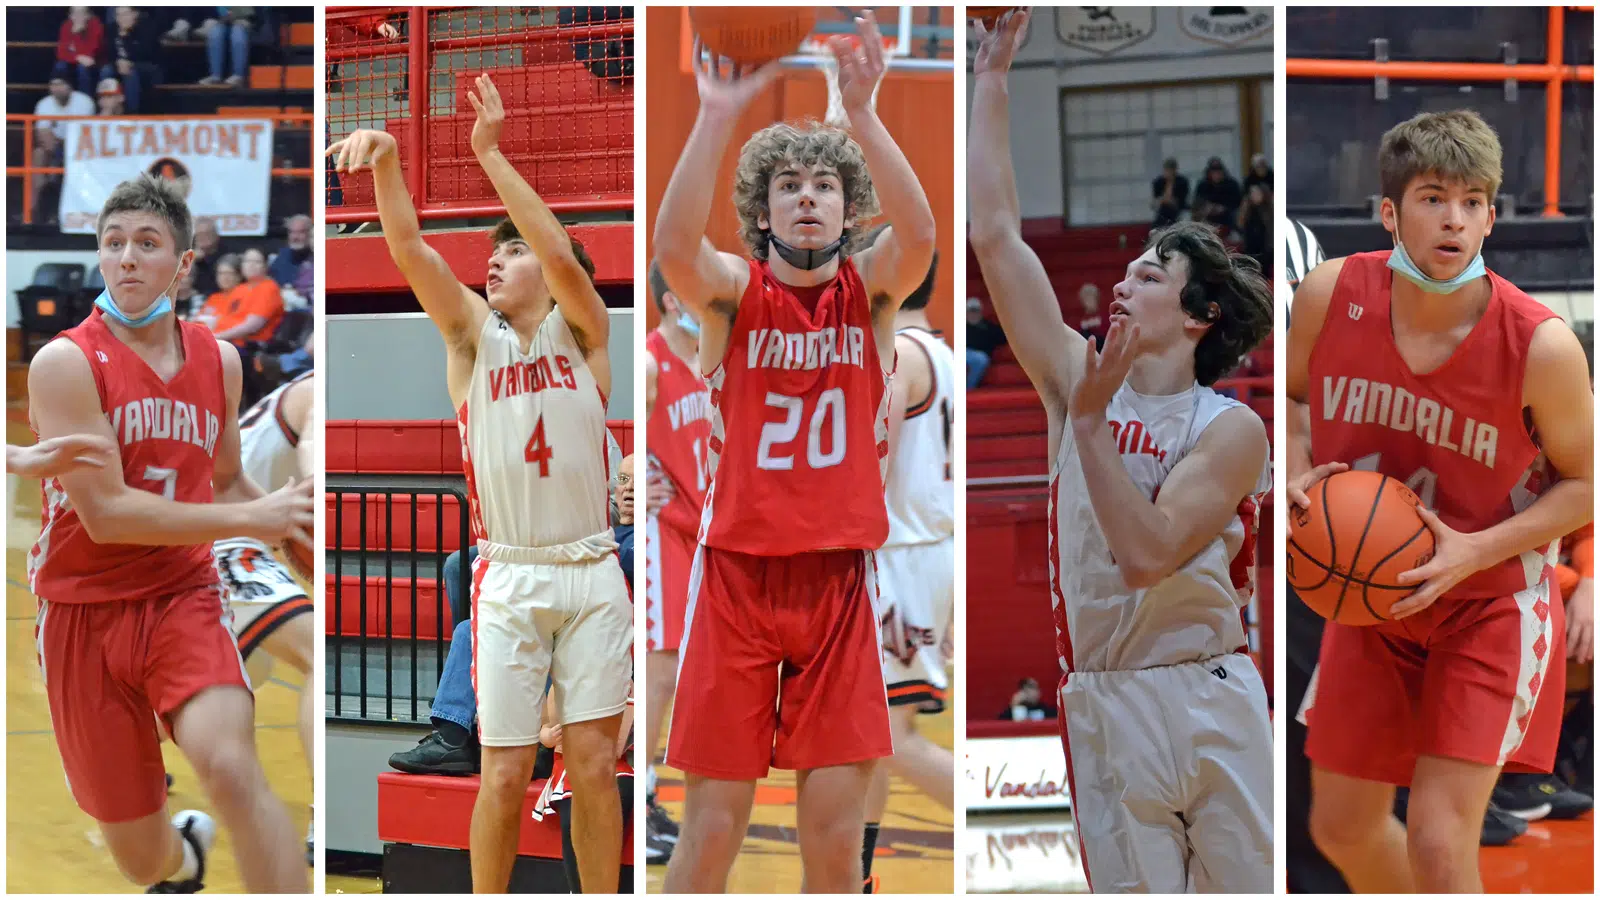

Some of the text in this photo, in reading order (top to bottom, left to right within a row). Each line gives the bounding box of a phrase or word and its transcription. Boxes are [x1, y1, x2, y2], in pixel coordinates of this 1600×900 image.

[75, 124, 264, 161] ALTAMONT
[747, 324, 864, 371] VANDALIA
[524, 412, 553, 478] 4
[757, 387, 847, 470] 20
[1323, 376, 1499, 470] VANDALIA
[143, 465, 177, 501] 7
